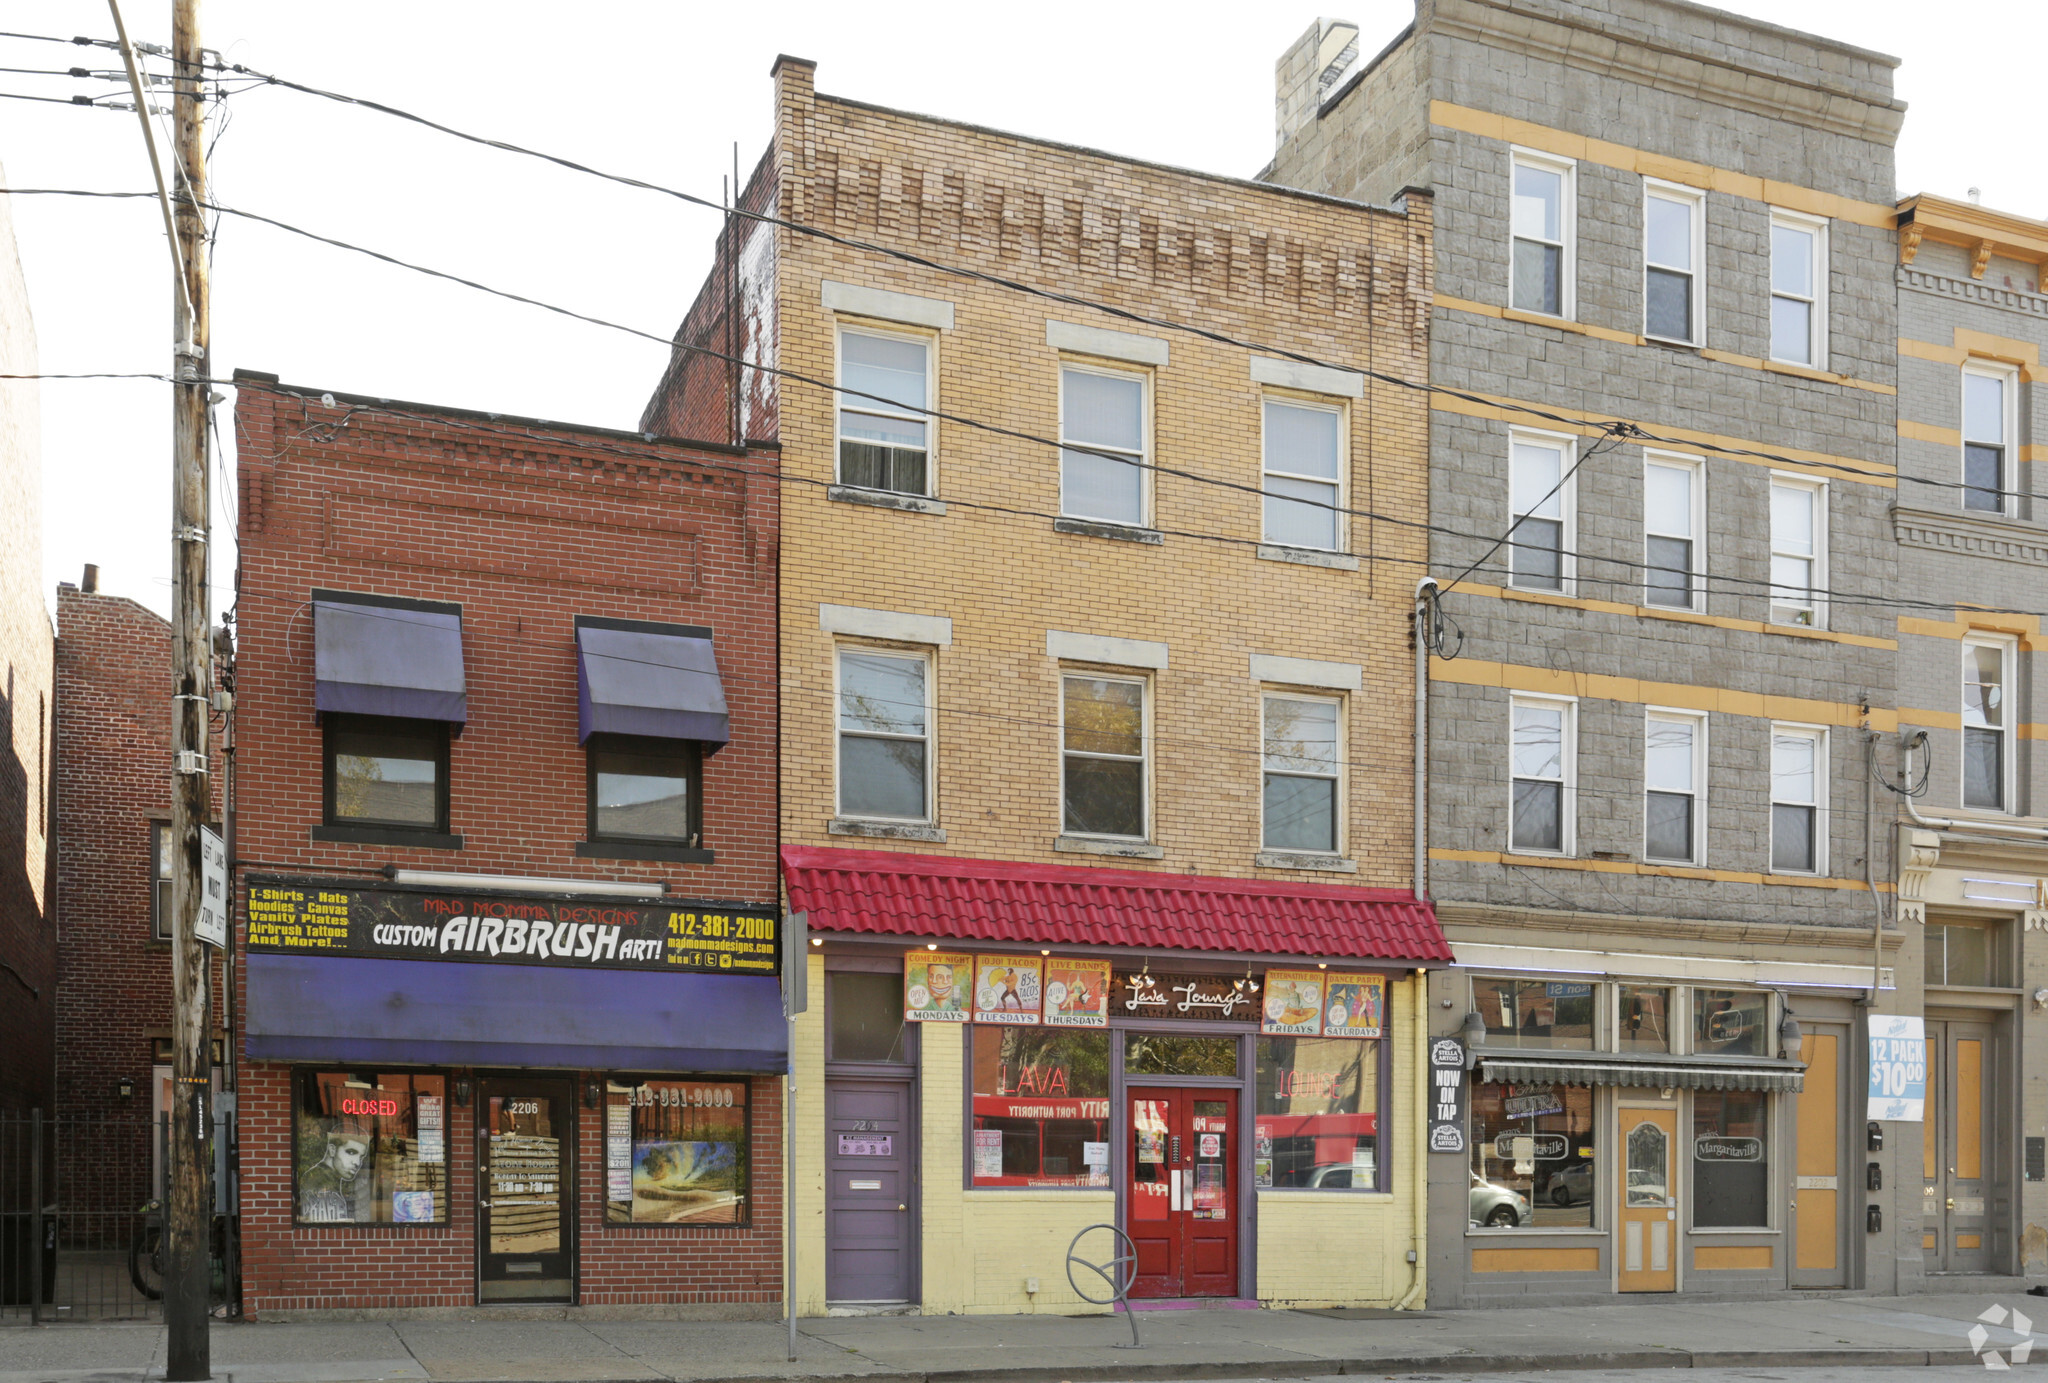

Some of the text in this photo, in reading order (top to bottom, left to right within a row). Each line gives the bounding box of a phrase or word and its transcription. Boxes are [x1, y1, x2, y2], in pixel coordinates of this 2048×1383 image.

[203, 842, 224, 870] LEFT LANE
[208, 875, 221, 900] MUST
[249, 888, 304, 901] T-Shirts
[318, 892, 348, 904] Hats
[249, 899, 295, 912] Hoodies
[307, 902, 348, 915] Canvas
[423, 898, 639, 925] MAD MOMMA DESIGNS
[202, 907, 225, 932] TURN LEFT
[249, 911, 348, 925] Vanity Plates
[668, 912, 774, 940] 412-381-2000
[249, 922, 348, 938] Airbrush Tattoos
[249, 934, 279, 945] And
[373, 916, 663, 963] CUSTOM AIRBRUSH ART!
[667, 937, 774, 955] madmommadesigns.com
[667, 954, 676, 963] find
[909, 954, 970, 964] COMEDY NIGHT
[1007, 959, 1038, 967] TACOS!
[1050, 961, 1072, 969] LIVE
[1020, 972, 1037, 987] 85¢
[910, 989, 926, 999] OPEN
[1019, 985, 1039, 998] TACOS
[1124, 980, 1169, 1010] Lava
[1172, 982, 1250, 1016] Lounge
[913, 1011, 964, 1020] MONDAYS
[979, 1013, 1034, 1022] TUESDAYS
[1046, 1015, 1104, 1025] THURSDAYS
[1269, 1024, 1313, 1033] FRIDAYS
[1326, 1027, 1377, 1036] SATURDAYS
[1872, 1039, 1923, 1062] 12 PACK
[1002, 1065, 1067, 1095] LAVA
[1280, 1070, 1341, 1099] LOUNGE
[1436, 1070, 1460, 1087] NOW
[1440, 1087, 1455, 1103] ON
[342, 1099, 398, 1116] CLOSED
[511, 1102, 538, 1114] 2206
[1437, 1104, 1457, 1120] TAP
[1699, 1142, 1757, 1157] Margaritaville
